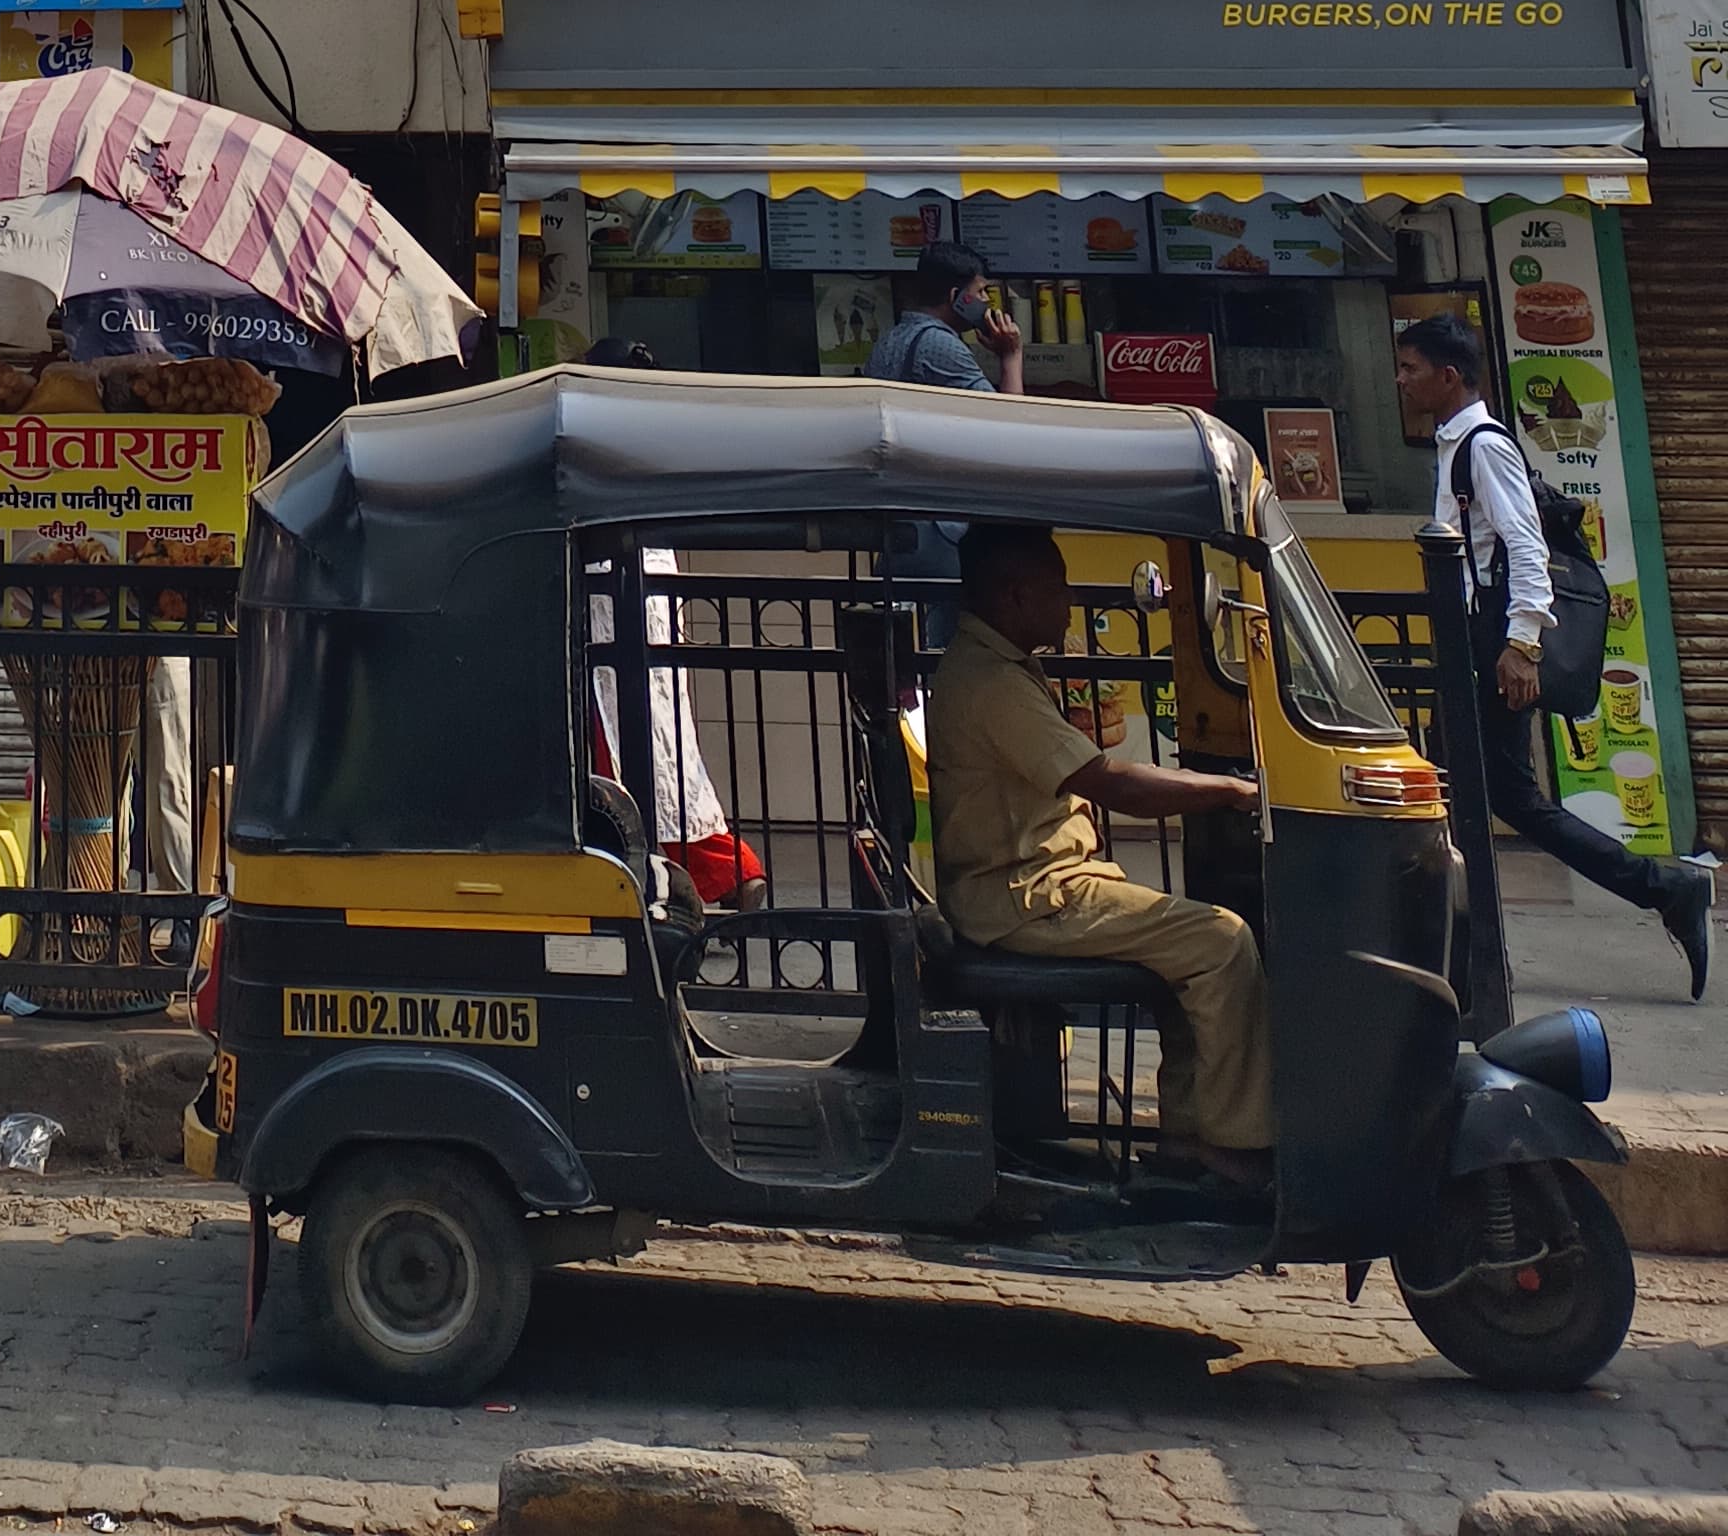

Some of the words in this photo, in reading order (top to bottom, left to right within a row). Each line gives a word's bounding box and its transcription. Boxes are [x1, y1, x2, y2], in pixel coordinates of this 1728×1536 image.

[1443, 1, 1505, 25] THE
[1515, 1, 1564, 25] GO
[1688, 19, 1713, 37] Jai
[1521, 221, 1551, 238] JK
[1521, 239, 1566, 248] BURGERS
[100, 309, 160, 334] CALL
[1106, 339, 1206, 374] Coca-Cola
[1513, 348, 1557, 358] MUMBAI
[1560, 348, 1603, 358] BURGER
[1557, 451, 1598, 468] Softy
[1562, 482, 1601, 495] FRIES
[60, 486, 142, 519] पानीपुरी
[146, 492, 194, 513] वाला
[37, 520, 87, 543] दहीपुरी
[289, 992, 531, 1042] MH.02.DK.4705
